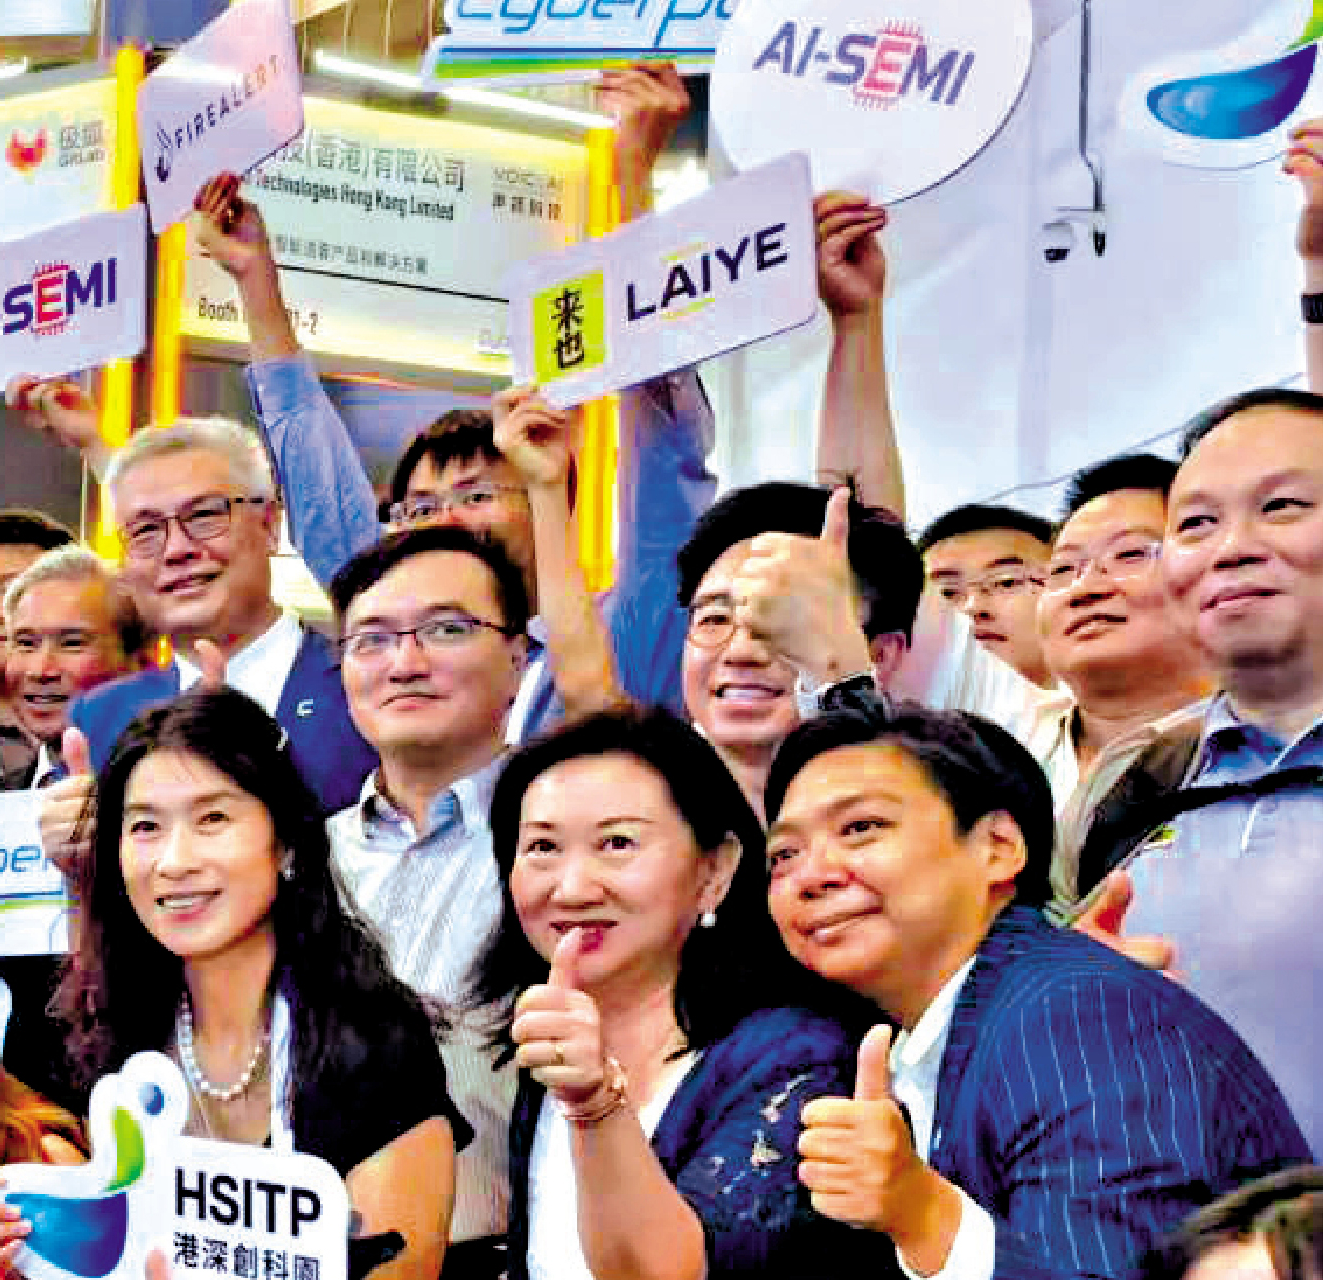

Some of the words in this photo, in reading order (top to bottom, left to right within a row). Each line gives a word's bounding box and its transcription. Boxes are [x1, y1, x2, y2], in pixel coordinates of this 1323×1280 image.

[754, 20, 975, 106] AI-SEMI
[626, 222, 789, 322] LAIYE
[551, 288, 585, 371] 来也
[174, 1167, 323, 1240] HSITP
